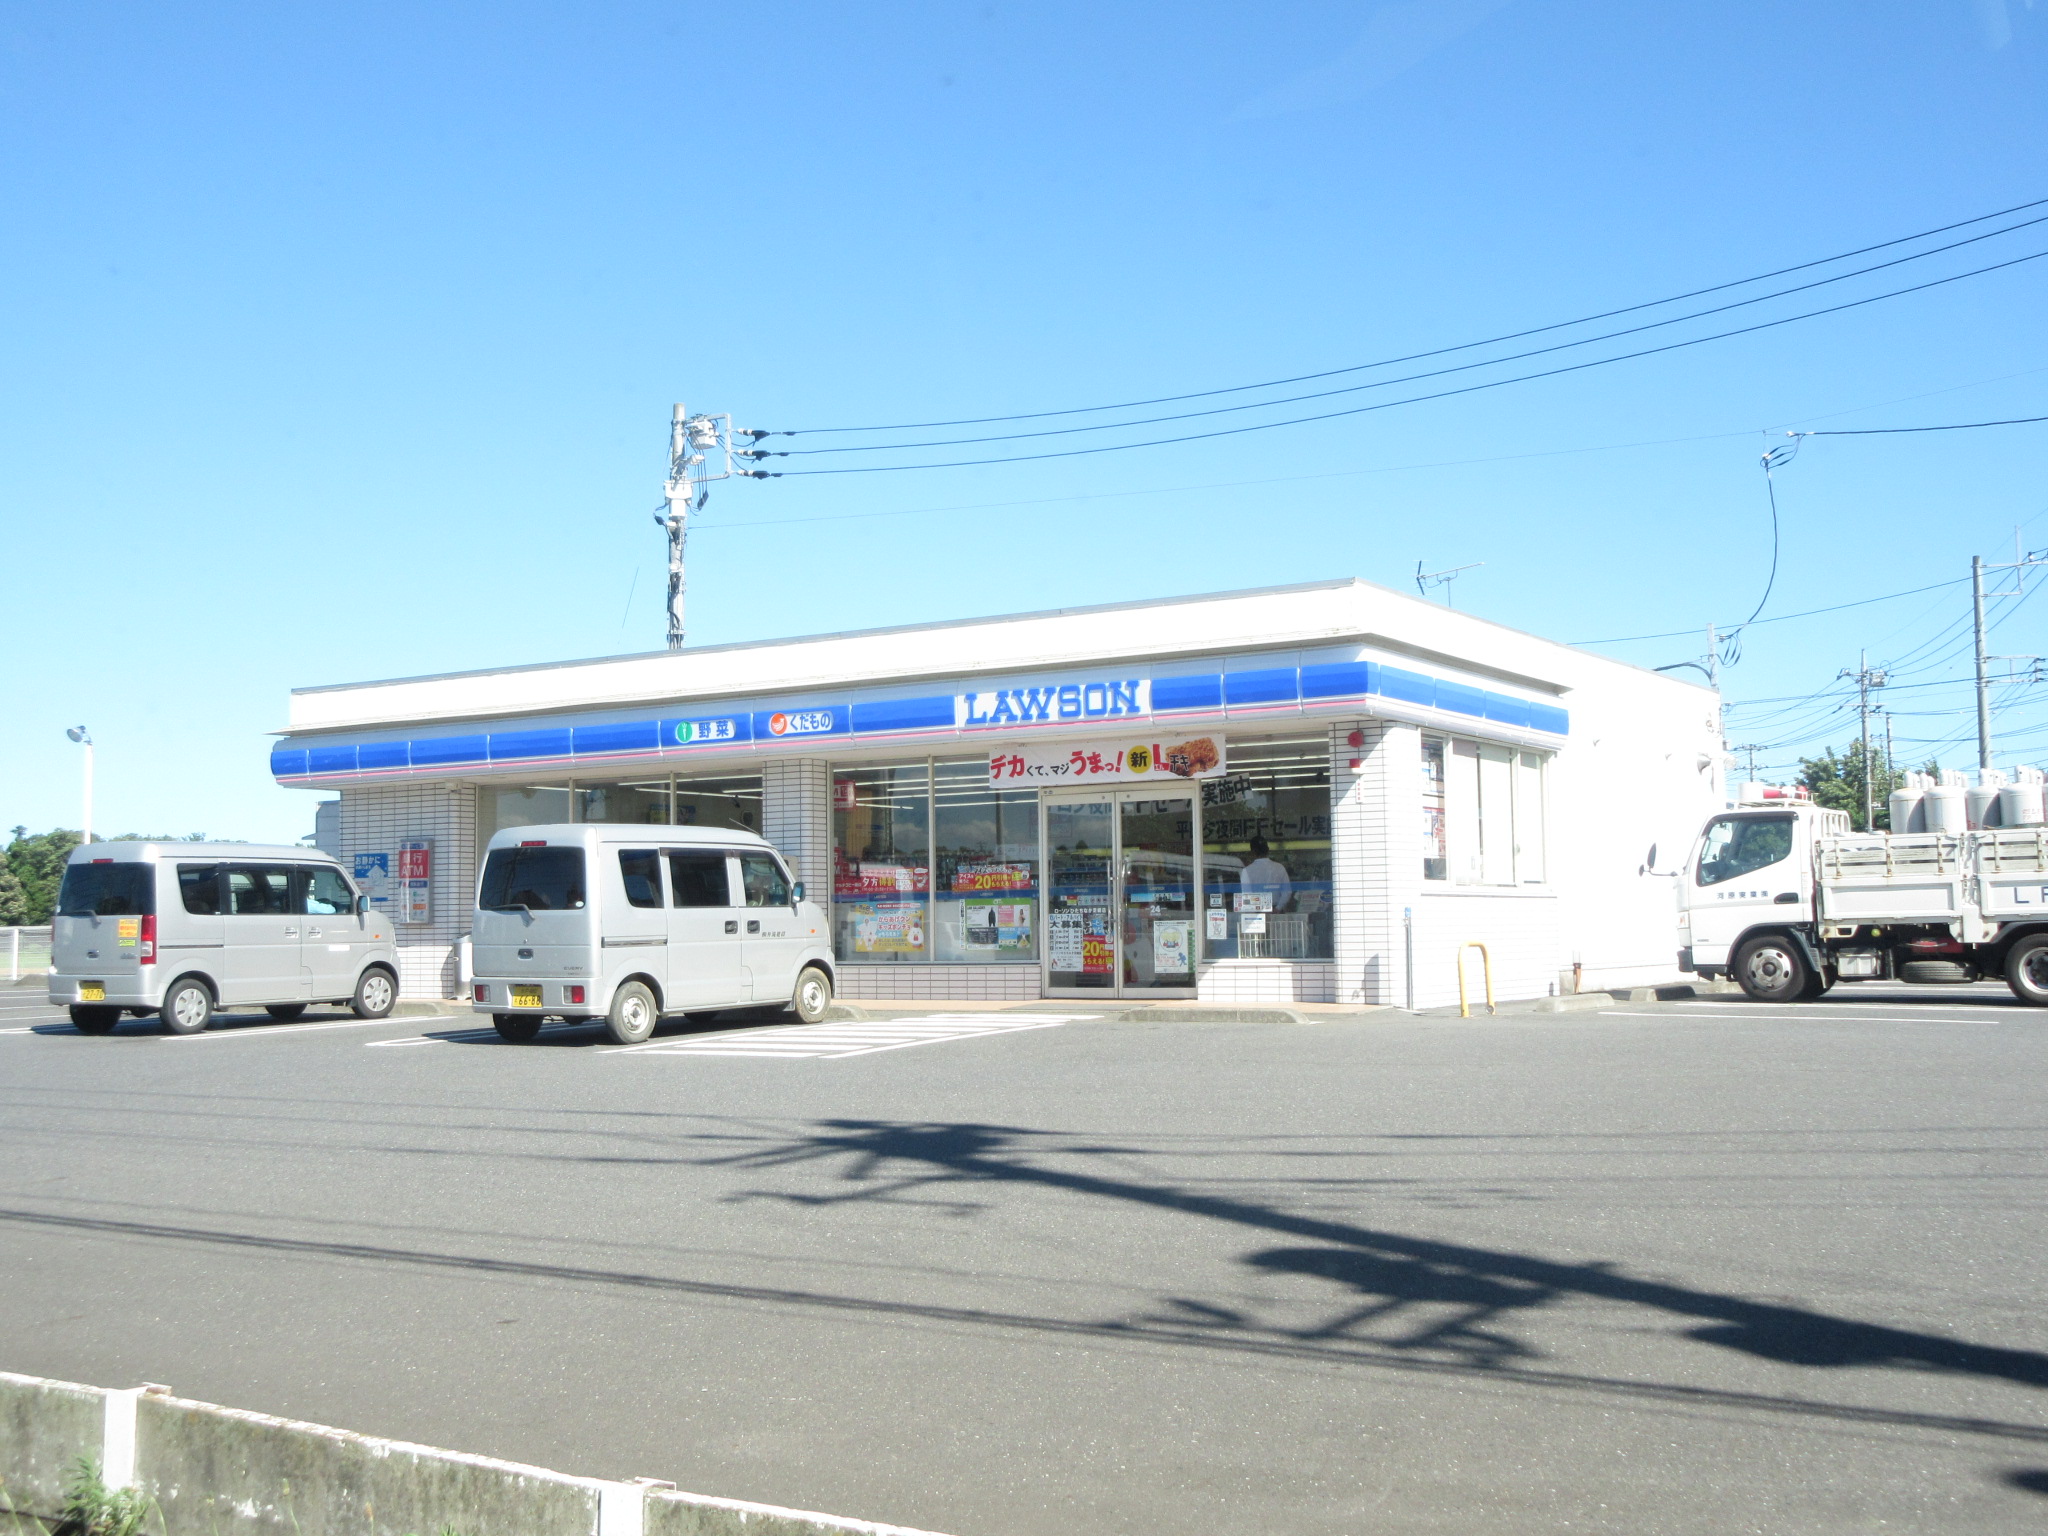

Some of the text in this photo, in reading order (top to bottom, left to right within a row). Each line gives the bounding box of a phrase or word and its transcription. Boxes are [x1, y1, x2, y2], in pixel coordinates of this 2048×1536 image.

[964, 680, 1141, 725] LAWSON
[697, 720, 729, 739] 野菜
[788, 713, 831, 731] くだもの
[1130, 751, 1148, 768] 新
[401, 865, 424, 876] ATM
[975, 874, 992, 889] 20
[1149, 905, 1161, 913] 24
[1049, 920, 1083, 929] 大募集
[1083, 941, 1100, 957] 20
